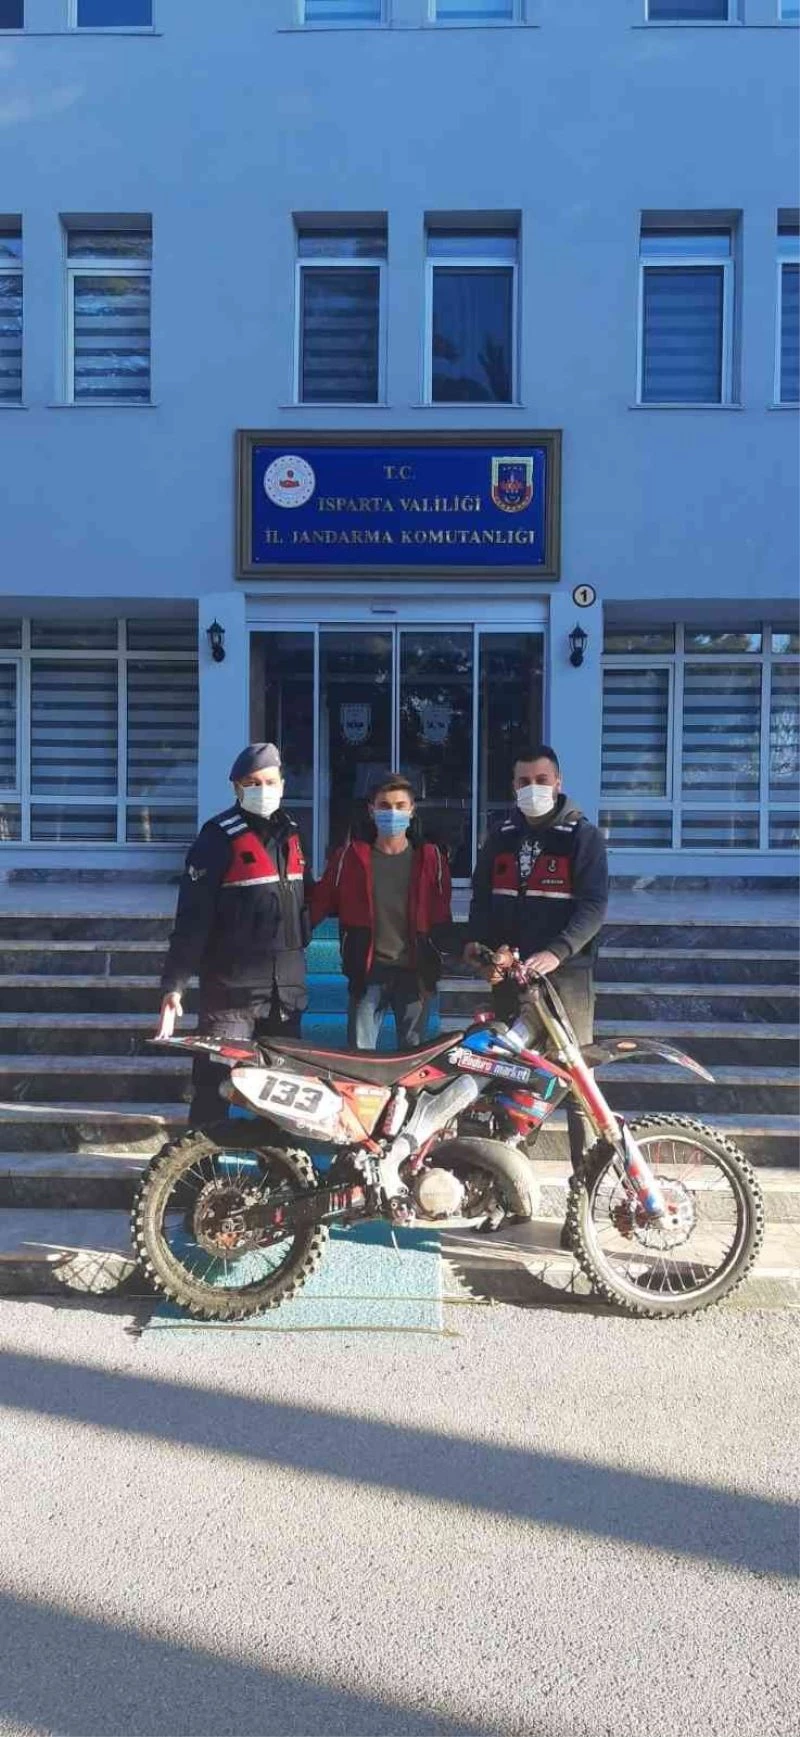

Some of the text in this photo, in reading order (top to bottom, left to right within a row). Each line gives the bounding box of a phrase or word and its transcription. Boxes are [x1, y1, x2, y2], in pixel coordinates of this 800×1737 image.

[383, 464, 416, 480] T.C.
[317, 496, 394, 512] ISPARTA
[400, 494, 482, 512] VALİLİĞİ
[292, 529, 394, 544] JANDARMA
[580, 588, 588, 603] 1
[258, 1074, 324, 1114] 133
